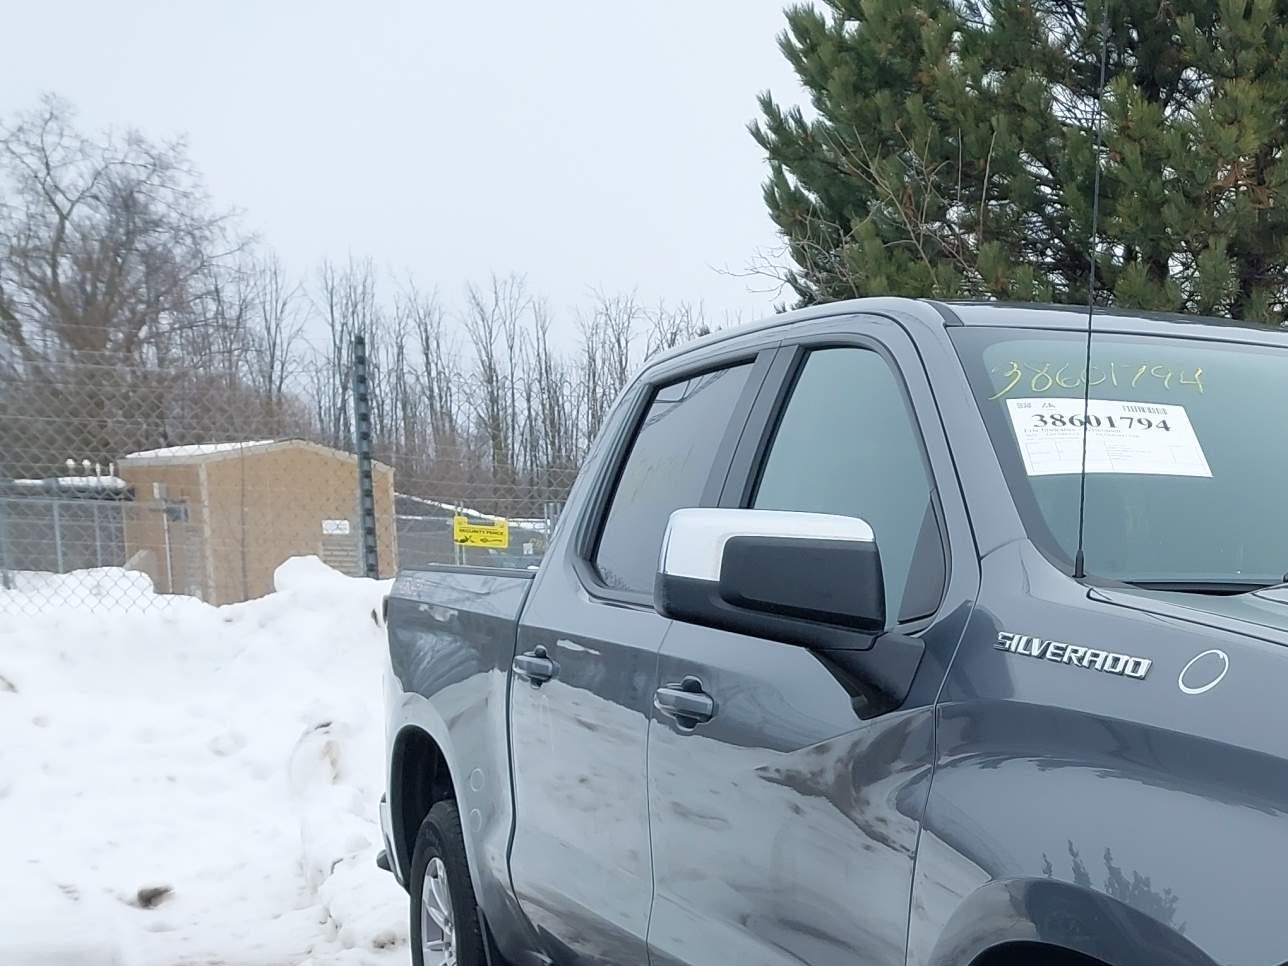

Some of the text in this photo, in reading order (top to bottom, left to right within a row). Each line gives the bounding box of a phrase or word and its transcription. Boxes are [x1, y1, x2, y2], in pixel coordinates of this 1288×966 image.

[988, 361, 1204, 400] 38601794
[1032, 413, 1171, 432] 38601794
[994, 632, 1152, 680] SILVERADO
